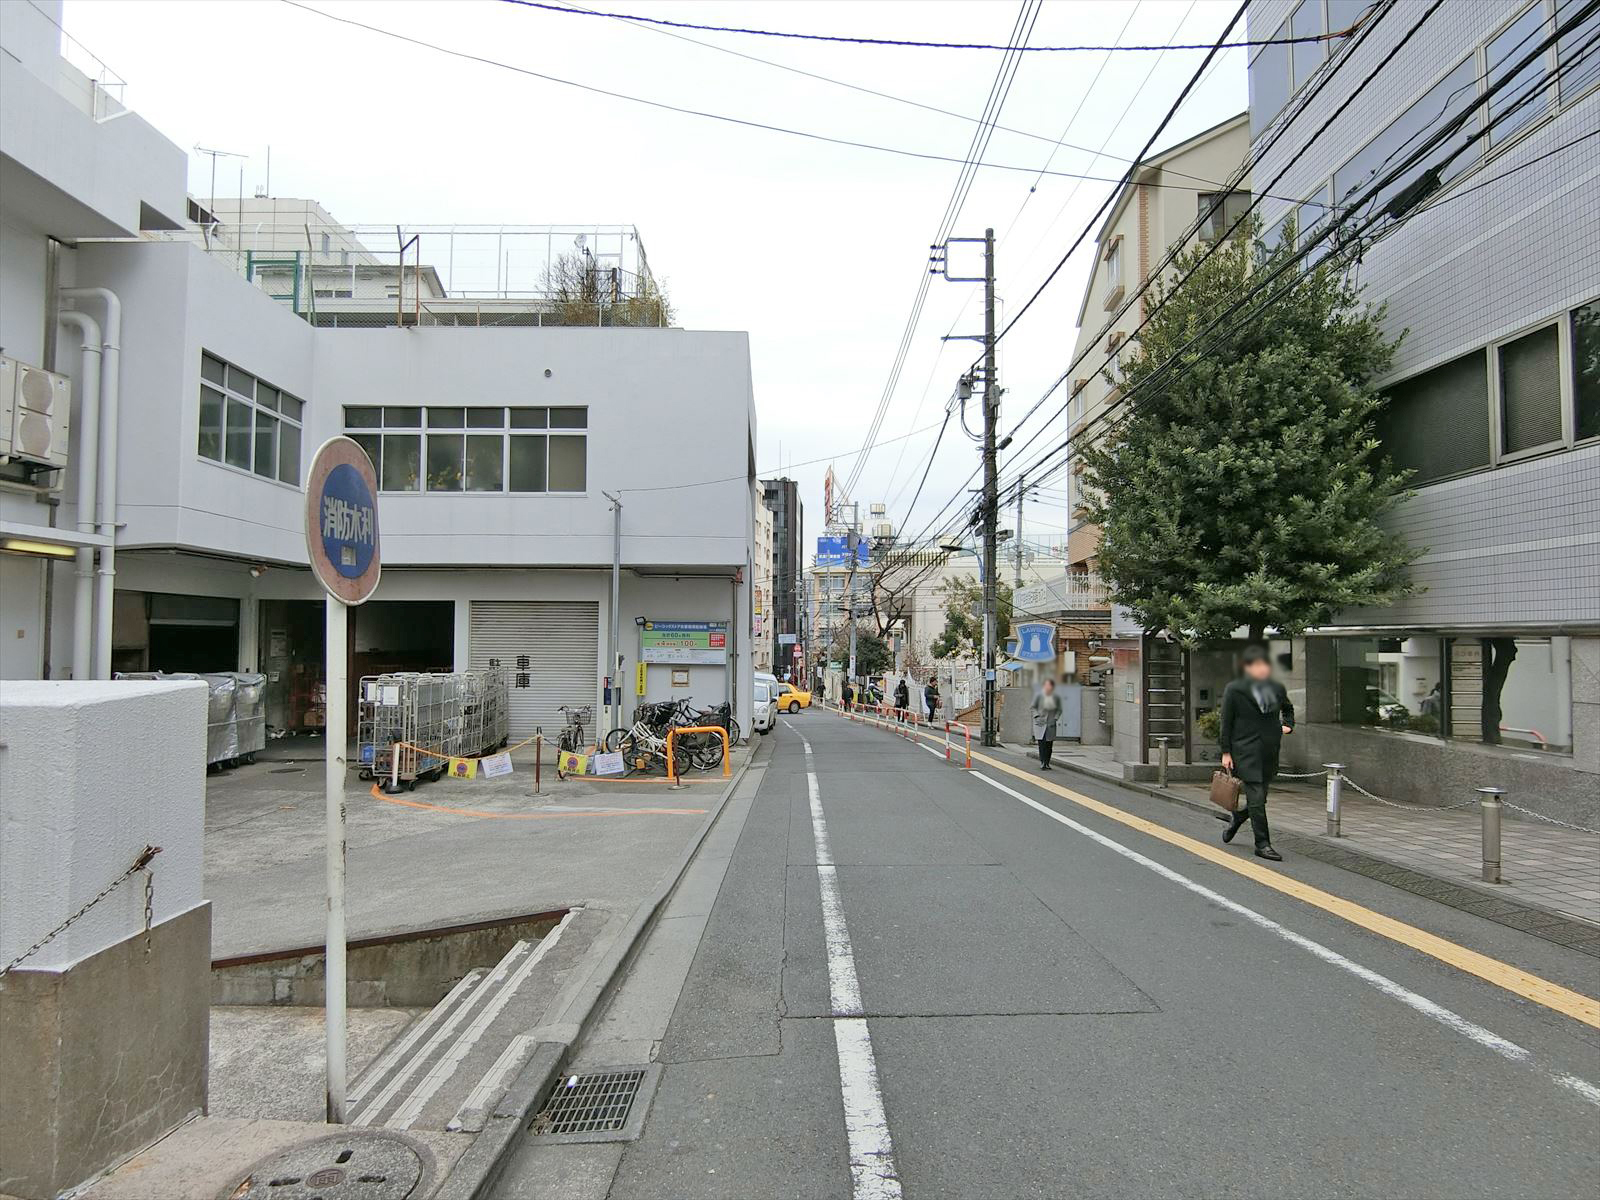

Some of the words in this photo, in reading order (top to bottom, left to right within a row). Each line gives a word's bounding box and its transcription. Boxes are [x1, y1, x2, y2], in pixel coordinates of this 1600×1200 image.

[323, 495, 374, 546] 消防水利
[1021, 626, 1050, 634] LAWSON
[515, 654, 531, 689] 車庫
[315, 1171, 339, 1186] 雨
